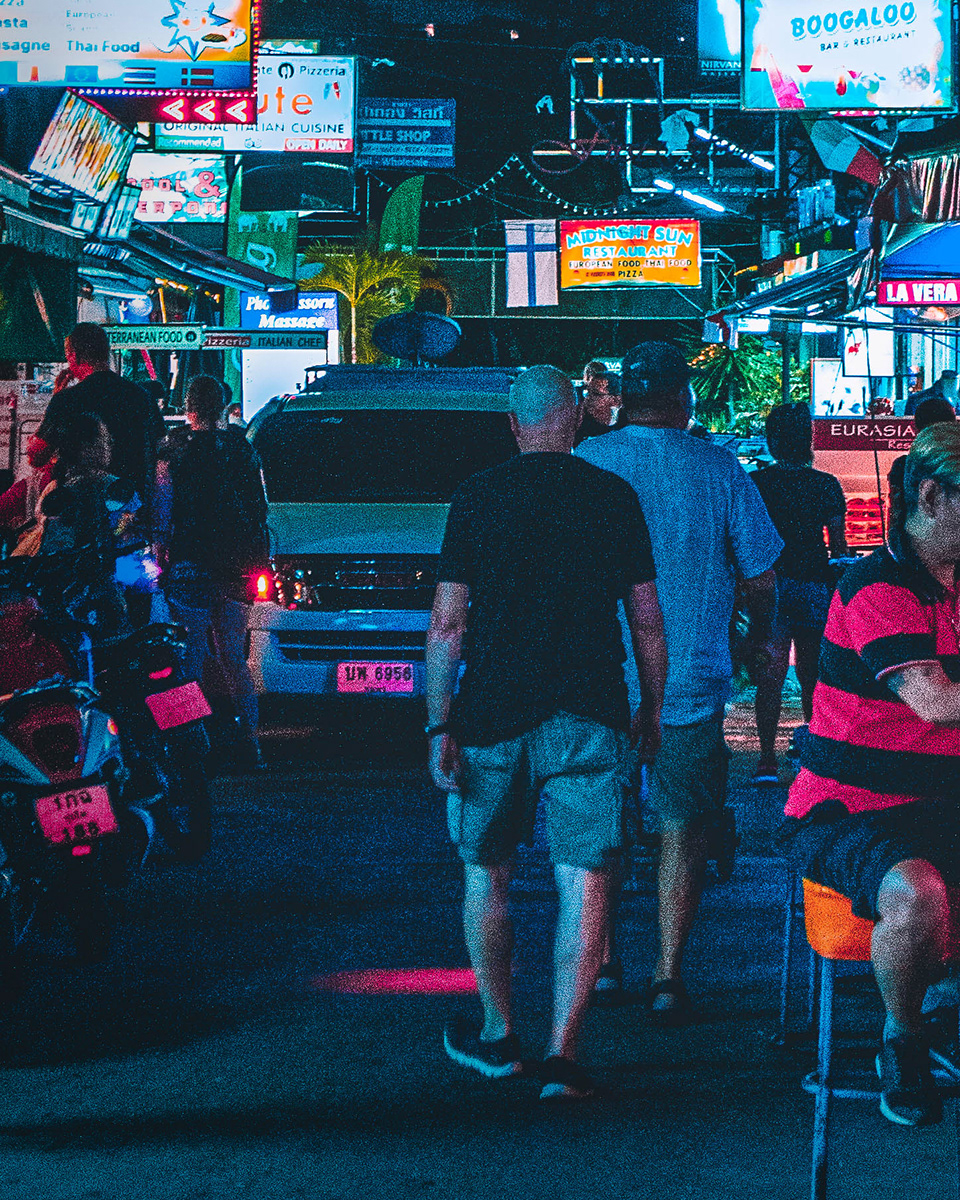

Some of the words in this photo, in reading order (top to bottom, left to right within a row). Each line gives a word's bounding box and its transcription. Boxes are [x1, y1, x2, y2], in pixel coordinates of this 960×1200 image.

[790, 1, 917, 40] BOOGALOO
[0, 42, 51, 54] sagne
[67, 40, 99, 52] Thai
[102, 40, 141, 53] Food
[819, 41, 839, 51] BAR
[853, 29, 916, 46] RESTAURANT
[299, 65, 346, 76] Pizzeria
[291, 122, 345, 134] CUISINE
[193, 171, 221, 198] &
[565, 224, 651, 249] MIDNIGHT
[653, 226, 694, 248] SUN
[582, 245, 679, 259] RESTAURANT
[668, 259, 692, 267] FOOD
[618, 270, 644, 278] PIZZA
[886, 283, 909, 302] LA
[912, 282, 958, 301] VERA
[258, 313, 326, 329] Massage
[159, 331, 183, 343] FOOD
[257, 337, 292, 347] ITALIAN
[297, 337, 321, 347] CHEF
